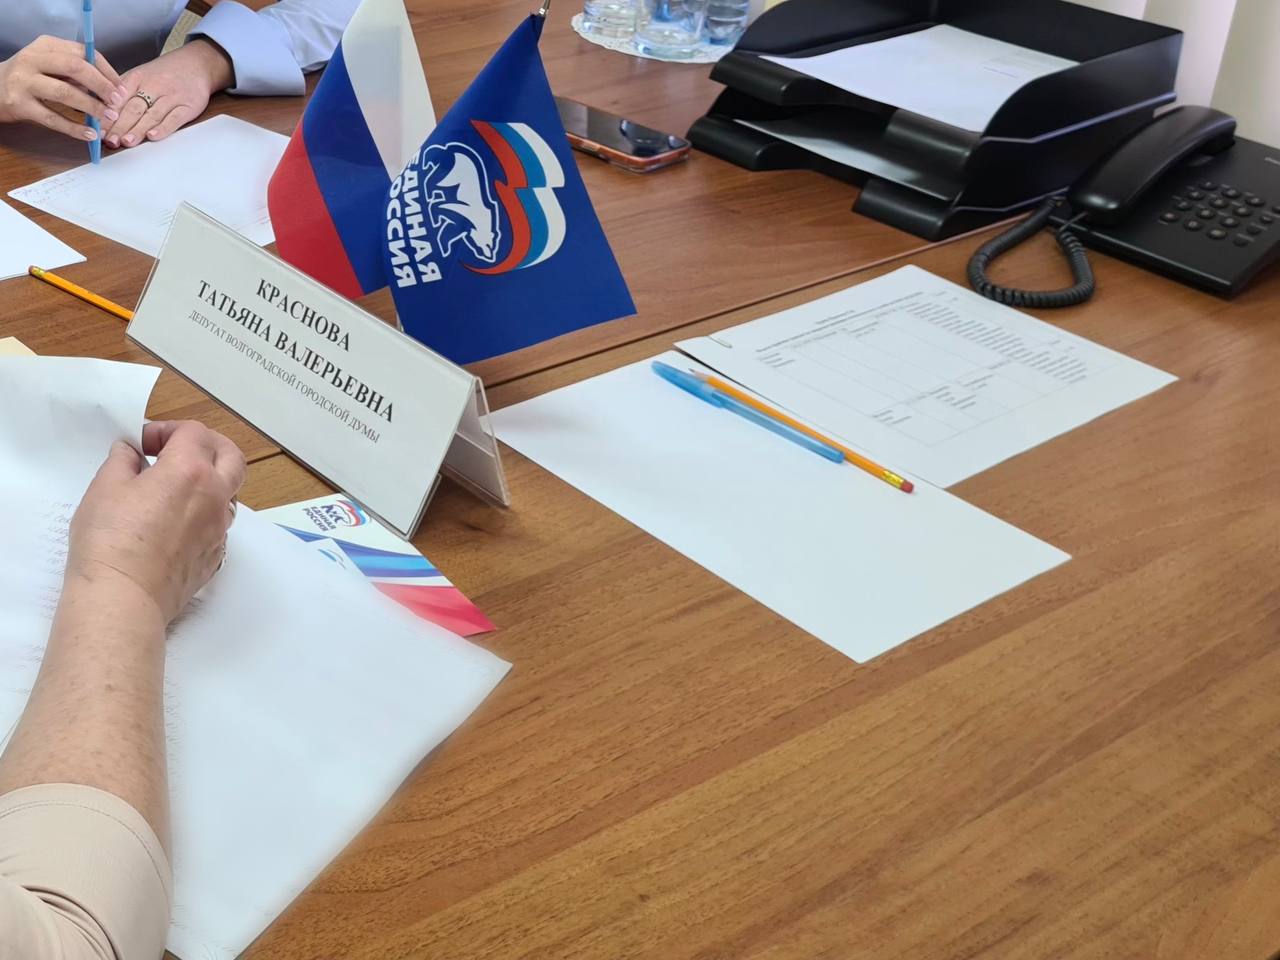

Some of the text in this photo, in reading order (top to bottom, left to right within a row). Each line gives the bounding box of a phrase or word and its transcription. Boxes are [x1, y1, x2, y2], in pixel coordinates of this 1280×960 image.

[387, 174, 417, 288] ОССИЯ
[188, 310, 381, 444] ДЕПУТАТ ВОЛГОГРАДСКОЙ ГОРОДСКОЙ ДУМЫ
[197, 280, 395, 423] ТАТЬЯНА ВАЛЕРЬЕВНА
[256, 279, 350, 352] КРАСНОВА
